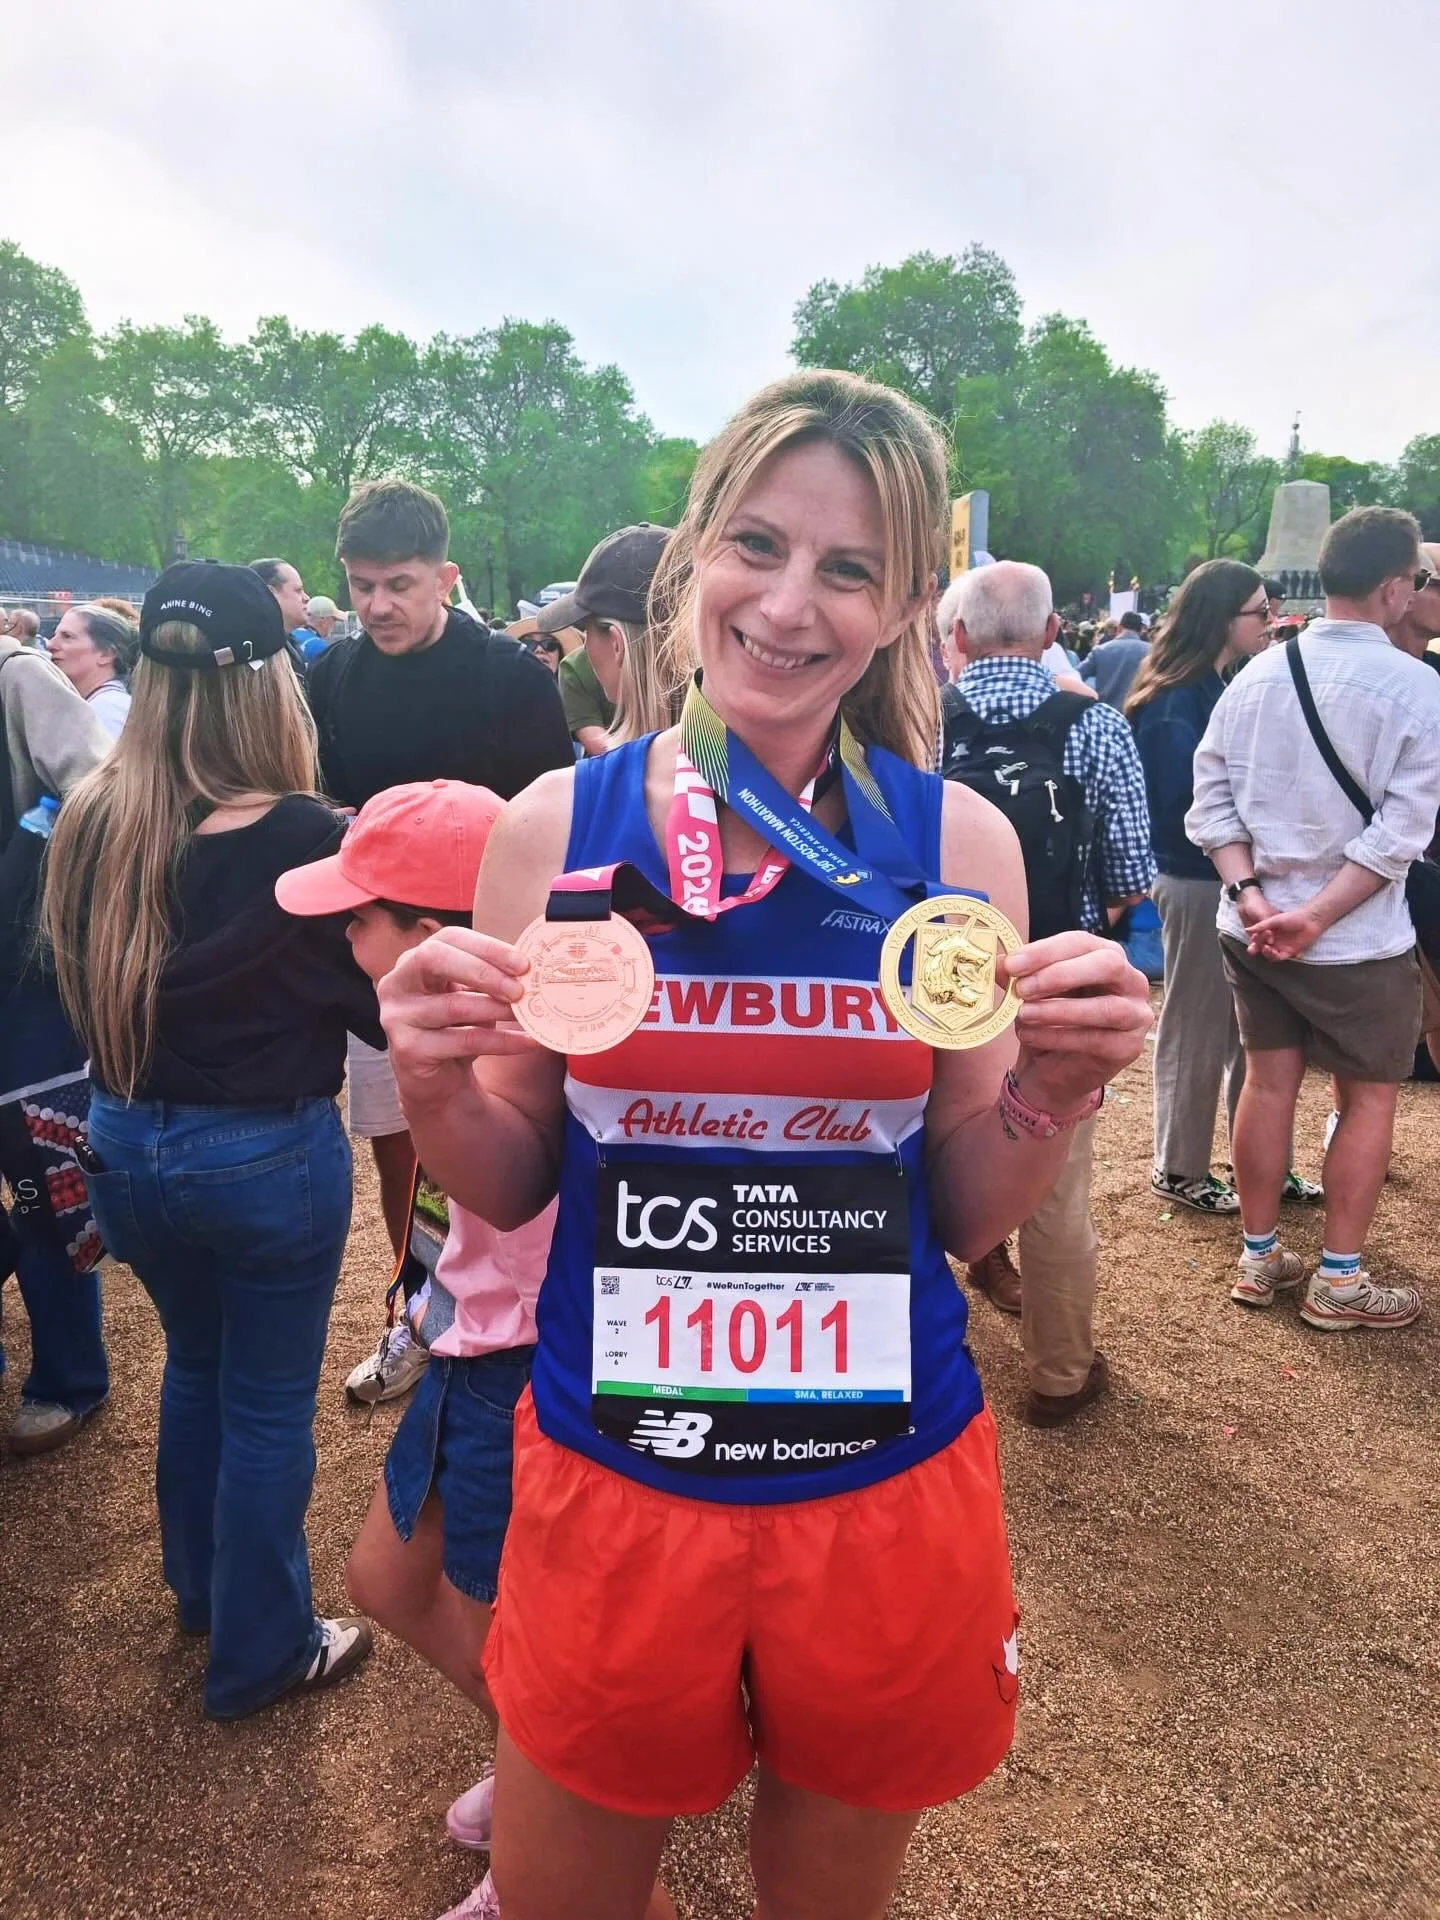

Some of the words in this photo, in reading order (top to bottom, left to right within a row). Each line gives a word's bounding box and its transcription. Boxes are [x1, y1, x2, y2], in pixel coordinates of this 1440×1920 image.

[160, 599, 187, 610] ANINE
[188, 601, 213, 617] BING
[738, 787, 787, 831] MARATHON
[790, 818, 821, 845] AMERICA
[780, 828, 820, 860] BOSTON
[817, 845, 829, 853] OF
[826, 852, 848, 867] BANK
[821, 909, 896, 935] FASTRAX
[643, 979, 899, 1032] WBURY
[618, 1098, 768, 1141] Athletic
[783, 1105, 872, 1142] Club
[732, 1184, 799, 1203] TATA
[616, 1180, 718, 1251] tcs
[732, 1210, 887, 1229] CONSULTANCY
[732, 1235, 831, 1253] SERVICES
[656, 1274, 673, 1286] tcs
[707, 1281, 785, 1292] #WeRunTogether
[606, 1319, 628, 1327] WAVE
[645, 1296, 848, 1373] 11011
[652, 1385, 684, 1396] MEDAL
[794, 1390, 819, 1401] SMA,
[821, 1390, 864, 1400] RELAXED
[715, 1440, 767, 1462] new
[773, 1438, 877, 1461] balance
